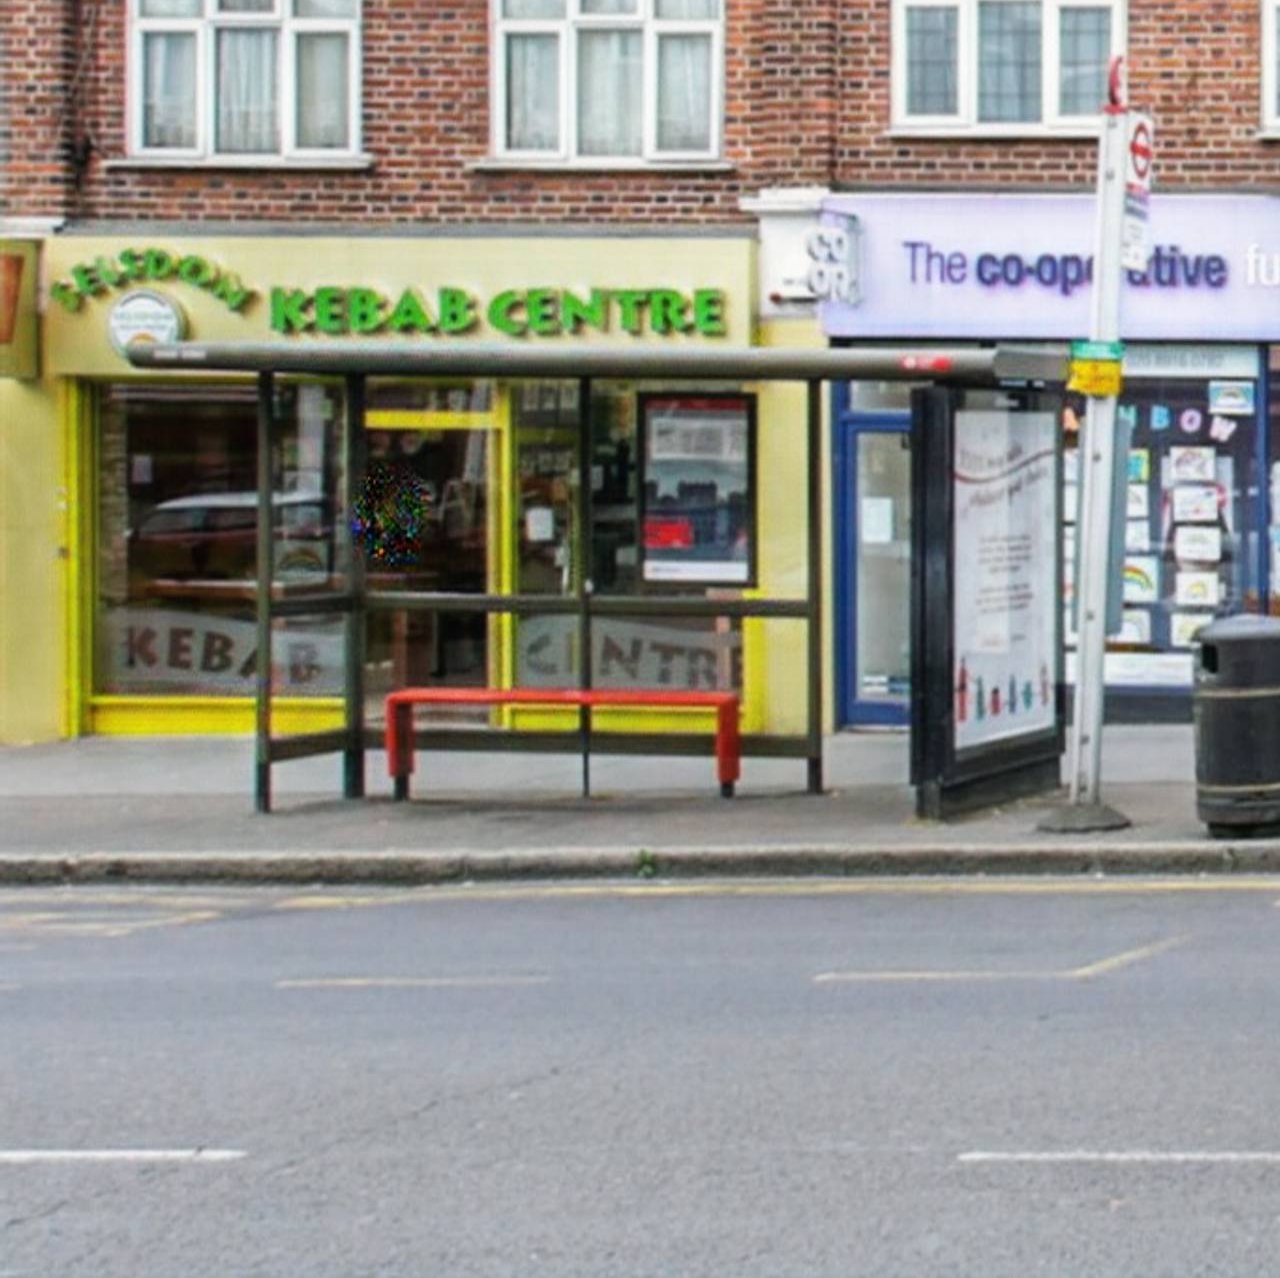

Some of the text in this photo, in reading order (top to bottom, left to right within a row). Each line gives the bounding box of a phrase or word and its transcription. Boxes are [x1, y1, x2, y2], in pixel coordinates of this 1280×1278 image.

[51, 248, 252, 314] SELSDON
[902, 242, 967, 284] The
[270, 286, 727, 336] KEBAB CENTRE
